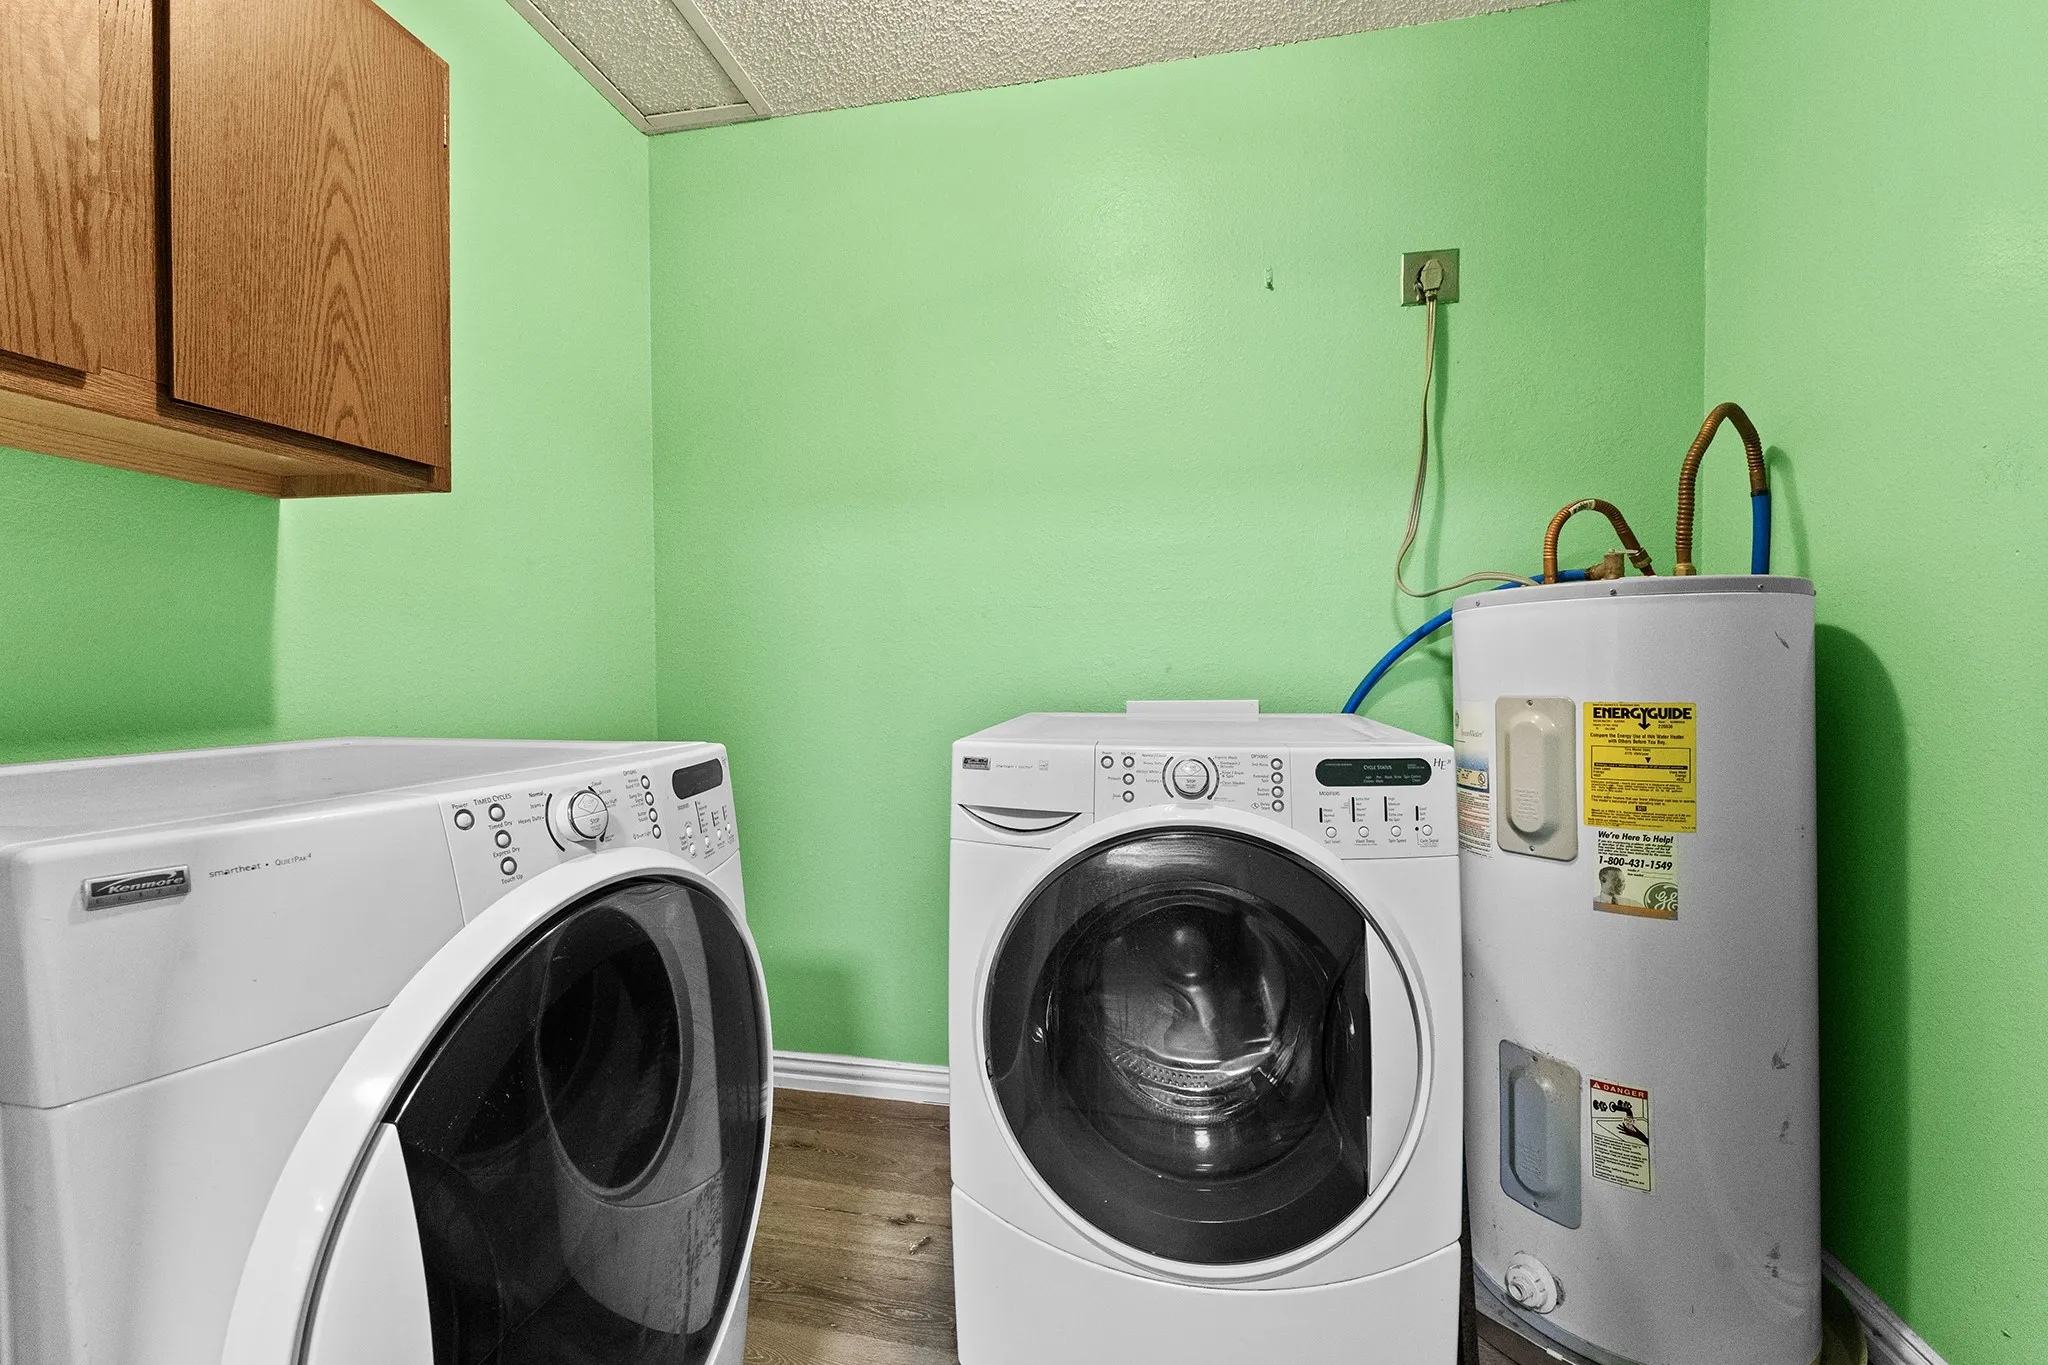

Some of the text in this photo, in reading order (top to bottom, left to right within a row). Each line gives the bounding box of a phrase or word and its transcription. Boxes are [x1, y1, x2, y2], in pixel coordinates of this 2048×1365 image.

[1593, 707, 1692, 720] ENERGYGUIDE
[1622, 833, 1640, 841] Here
[1653, 835, 1674, 844] Help!
[1599, 856, 1672, 870] 1-800-431-1549
[209, 863, 261, 878] smartheat
[108, 877, 184, 894] Kenmore
[1603, 1084, 1645, 1098] DANGER
